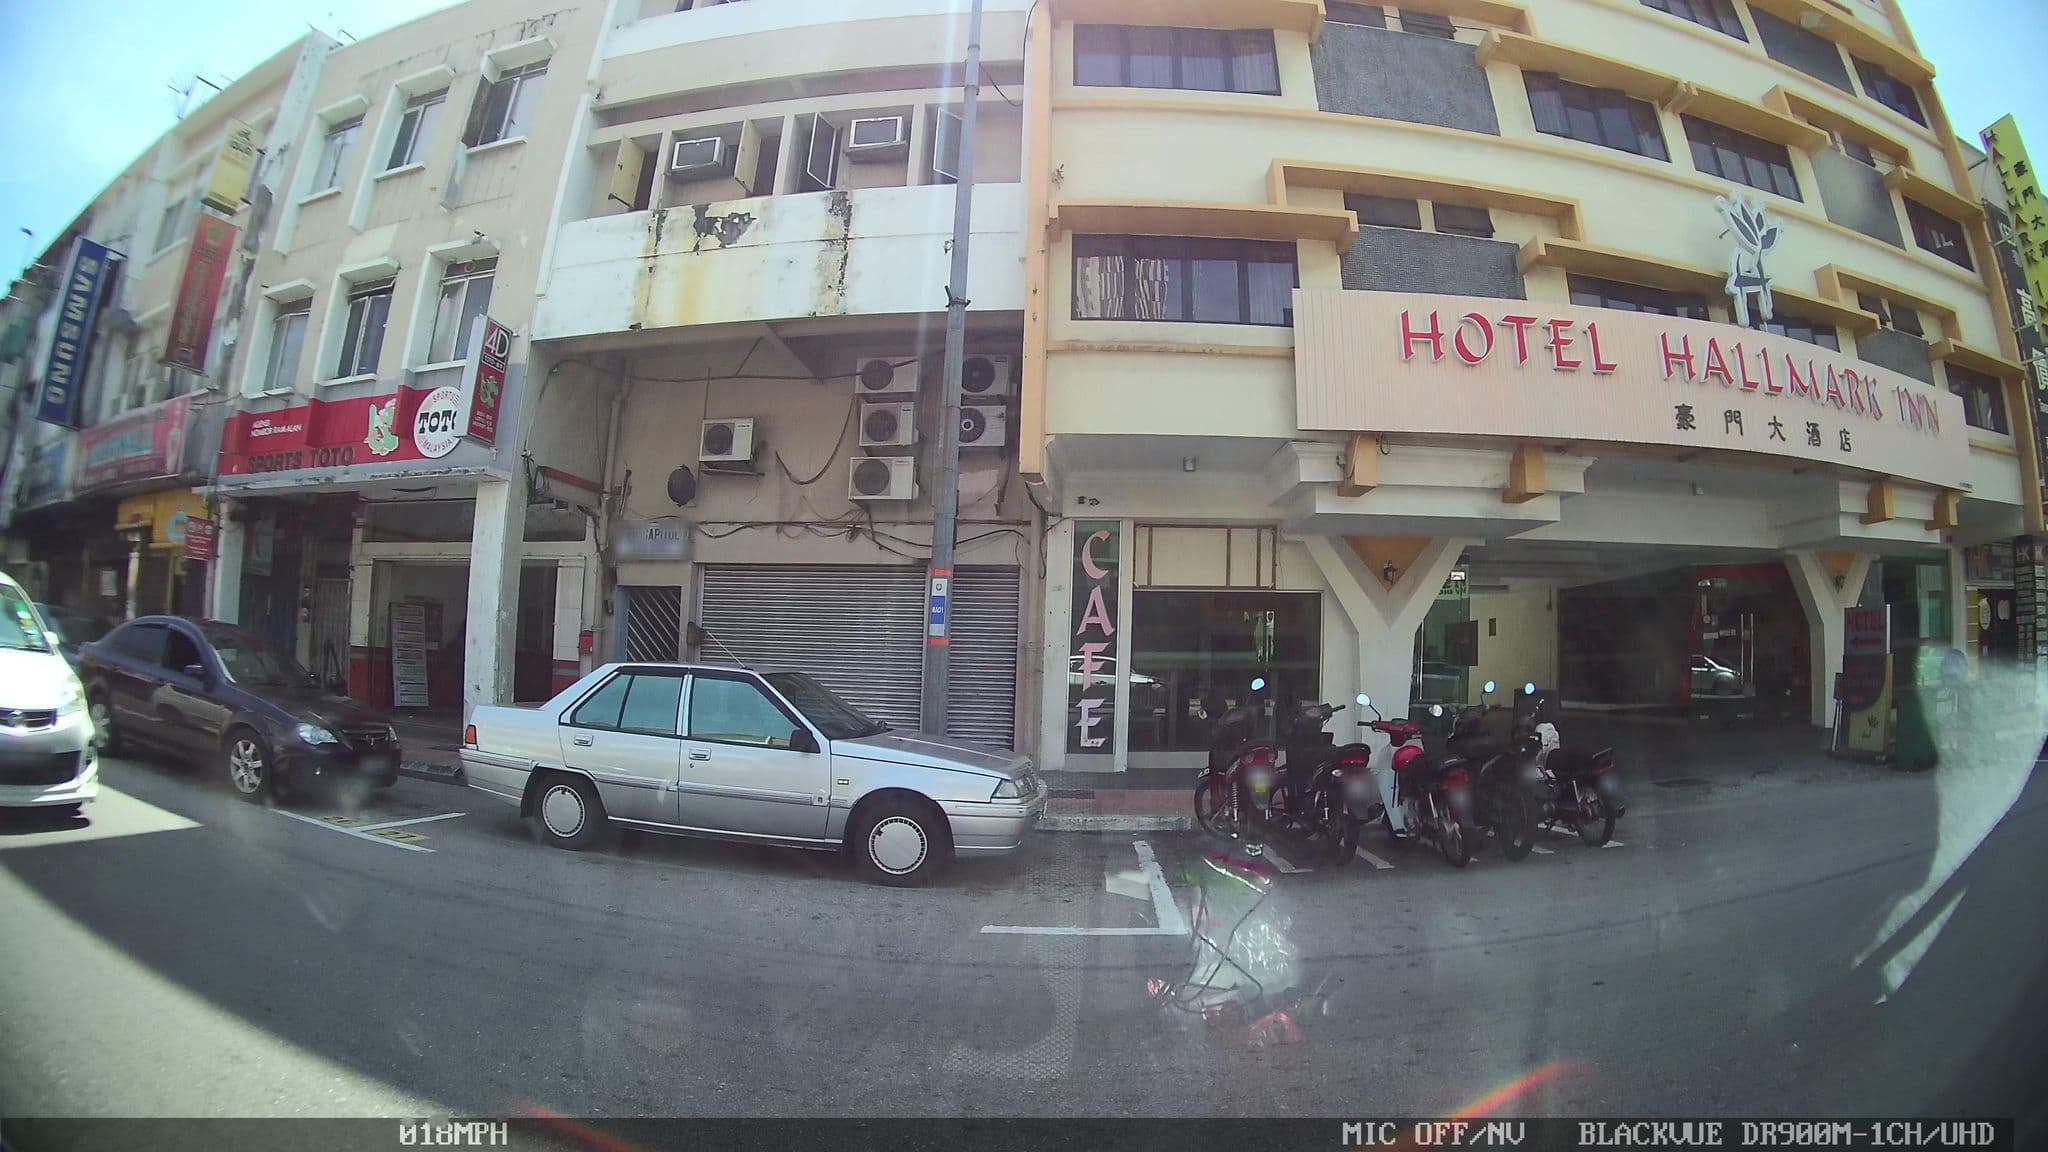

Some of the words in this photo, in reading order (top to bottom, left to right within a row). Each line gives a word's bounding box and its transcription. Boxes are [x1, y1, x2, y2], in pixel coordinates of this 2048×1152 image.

[46, 255, 99, 405] SAMSUNG
[485, 326, 510, 358] 4D
[1399, 307, 1619, 376] HOTEL
[1658, 331, 1884, 422] HALLMARK
[1893, 384, 1941, 435] INN
[248, 449, 304, 475] SPORTS
[309, 445, 356, 469] TOTO
[1674, 403, 1853, 453] 豪門大酒店
[1074, 529, 1117, 749] CAFE
